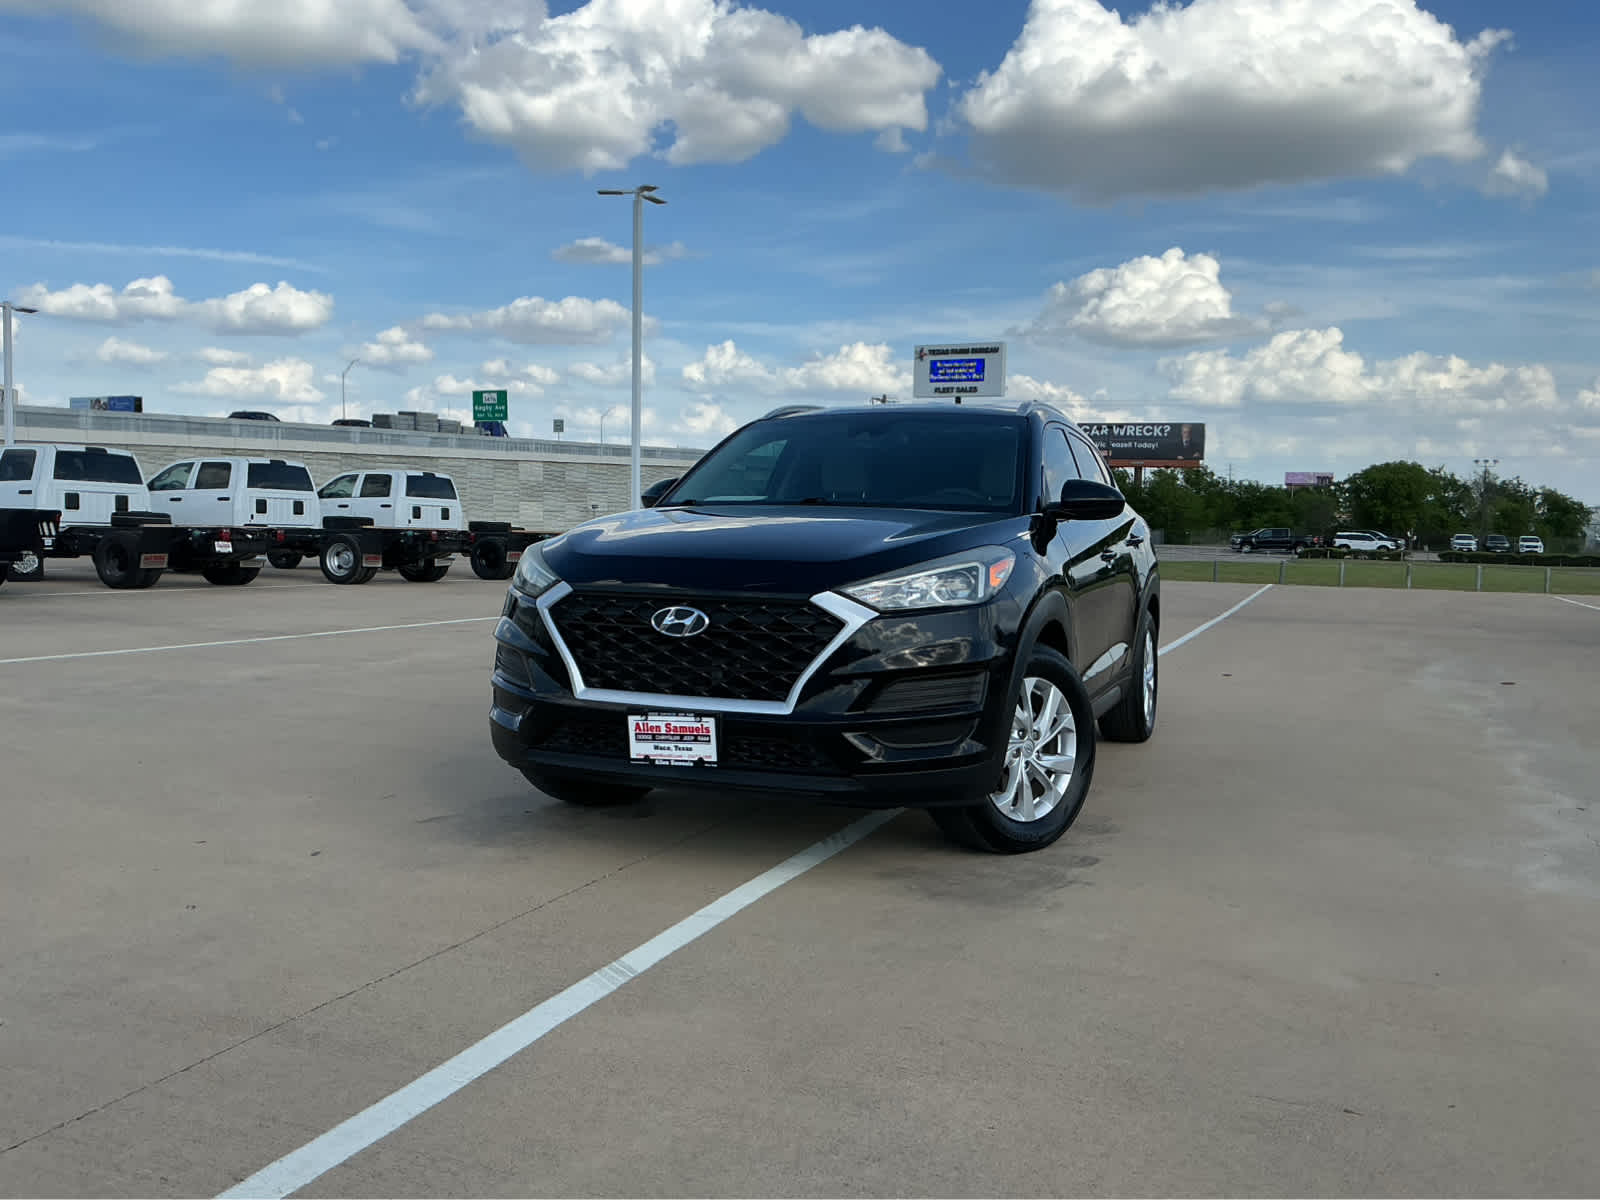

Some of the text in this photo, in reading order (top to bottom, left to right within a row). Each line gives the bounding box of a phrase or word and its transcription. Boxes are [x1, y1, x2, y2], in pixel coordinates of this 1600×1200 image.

[1080, 424, 1171, 436] CAR WRECK?
[635, 722, 711, 734] Allen Samuels
[674, 744, 693, 752] Texas
